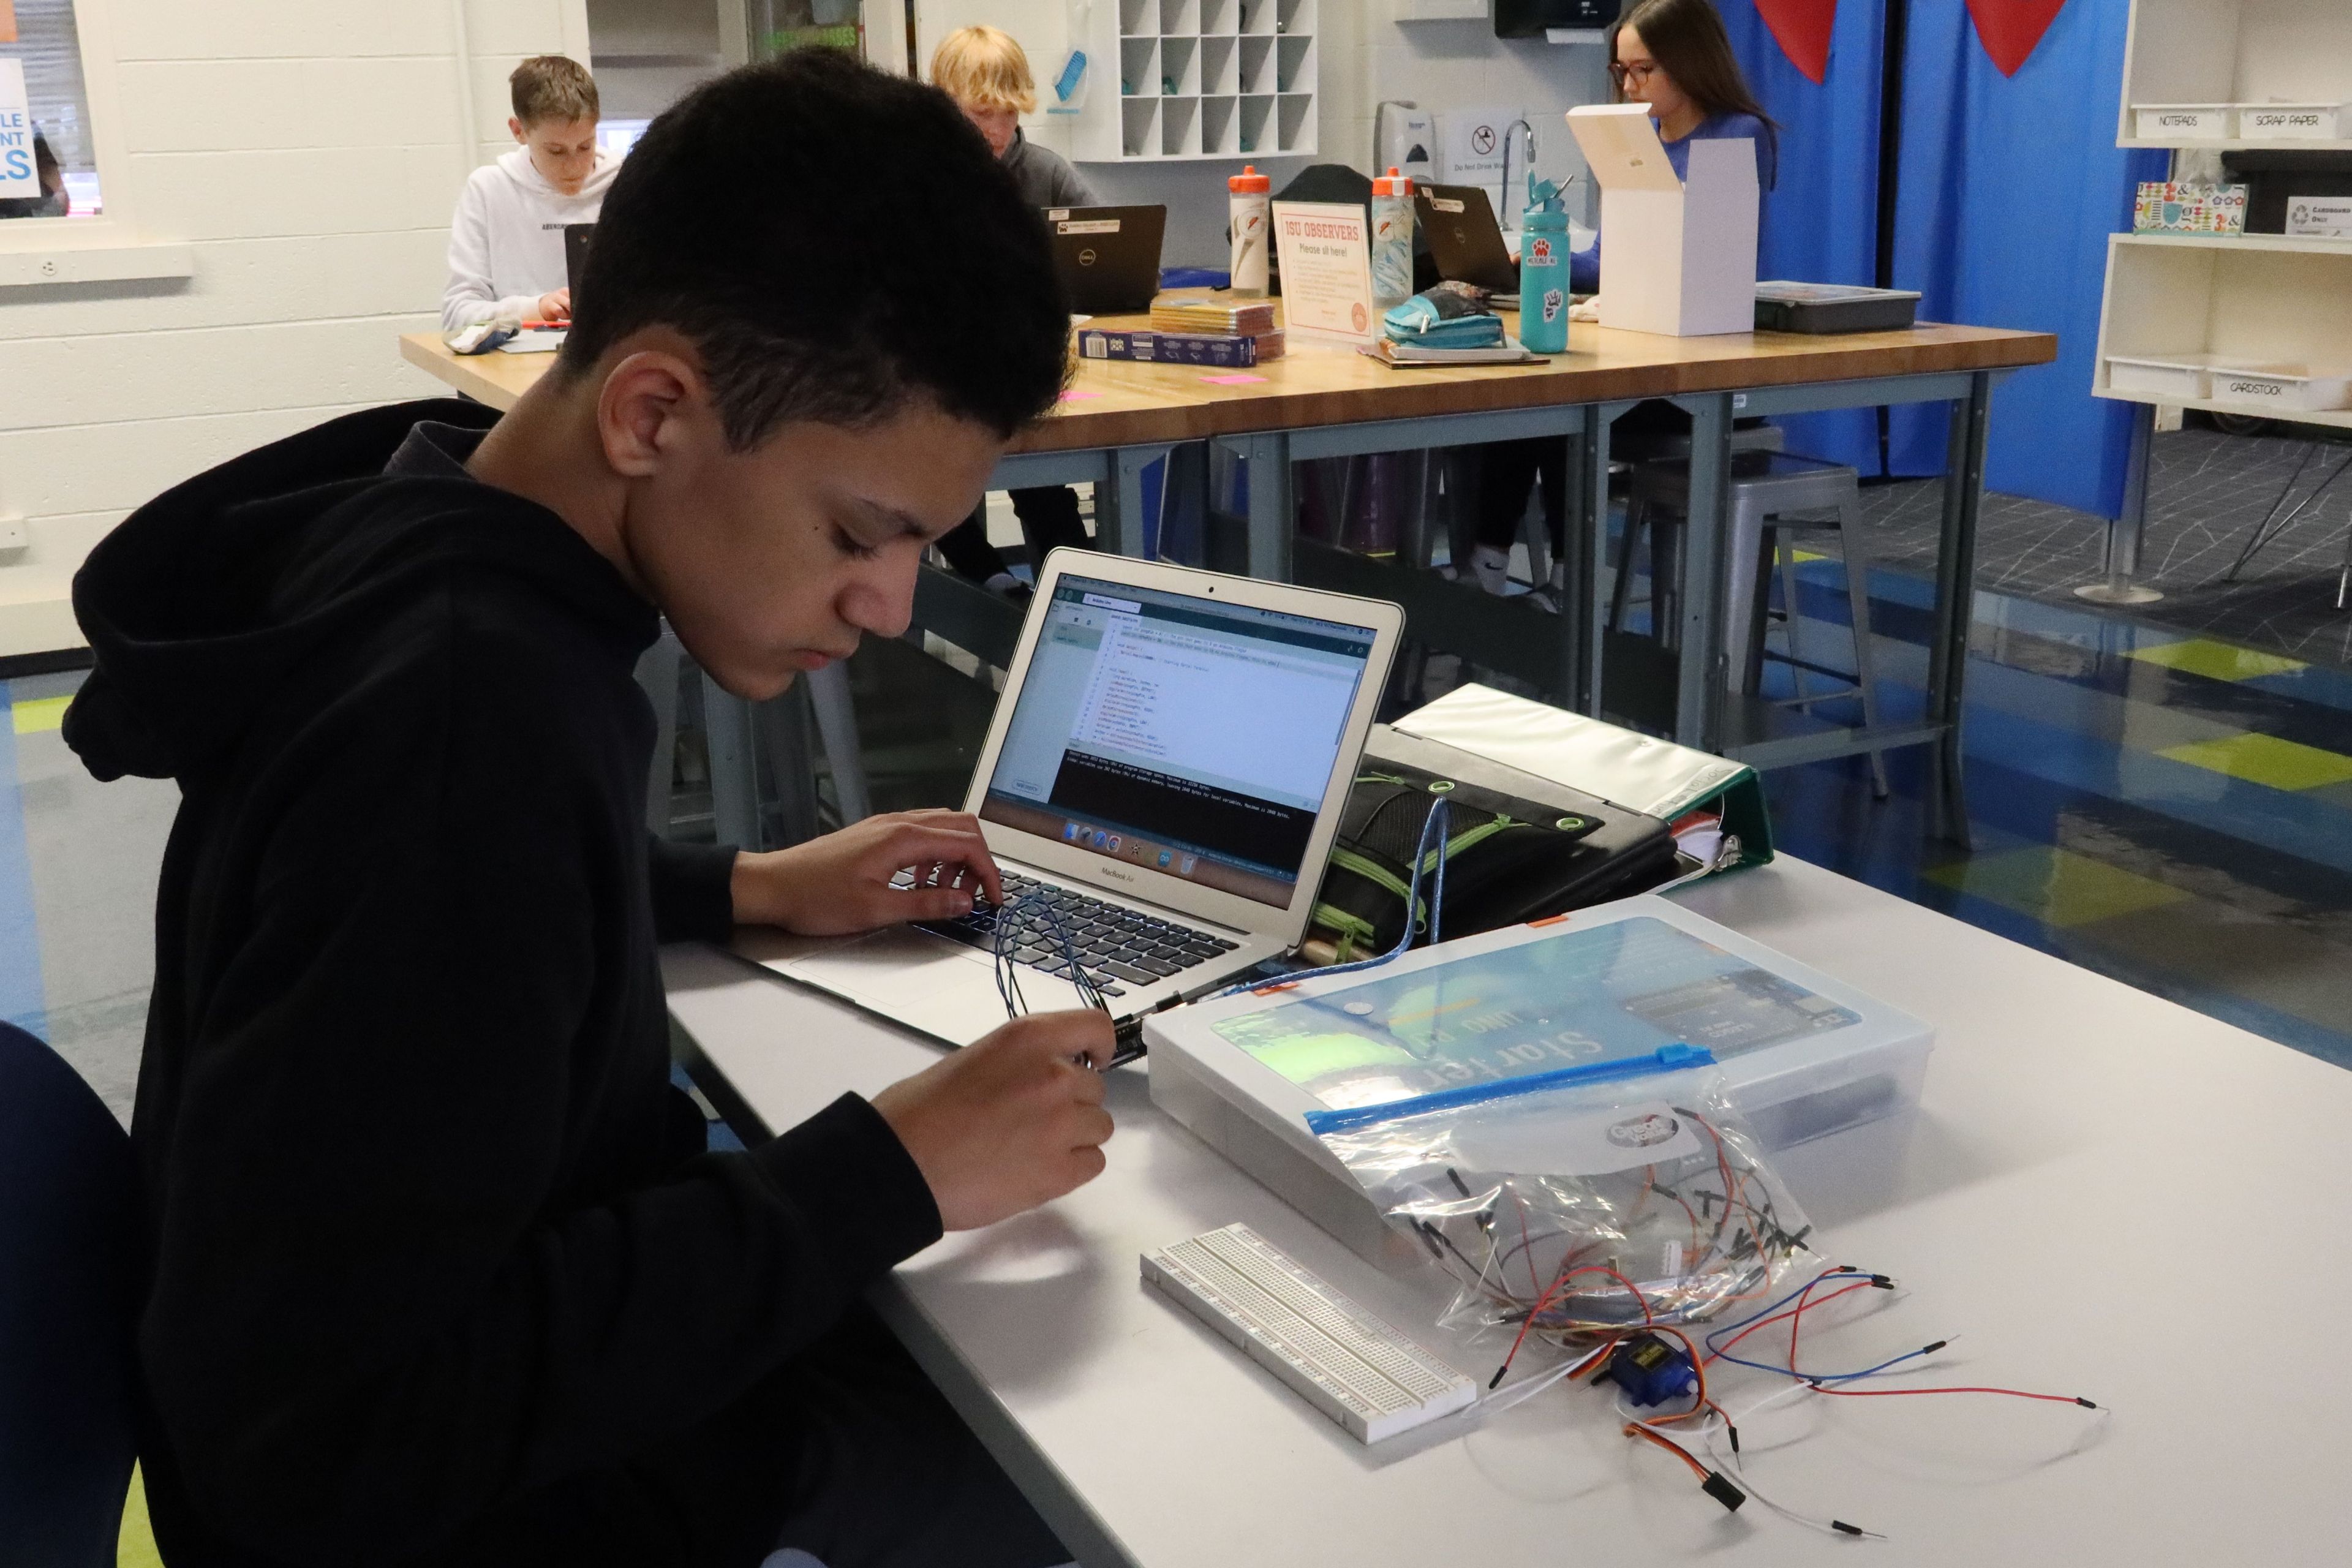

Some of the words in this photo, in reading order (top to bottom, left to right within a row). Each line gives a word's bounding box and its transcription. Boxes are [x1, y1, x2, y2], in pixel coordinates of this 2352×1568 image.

[2159, 115, 2198, 126] NOTEPADS
[2256, 115, 2286, 126] SCRAP
[2289, 115, 2319, 126] PAPER
[1286, 221, 1302, 236] ISU
[1304, 222, 1359, 241] OBSERVERS
[1299, 243, 1321, 255] Please
[1330, 246, 1347, 257] here!
[2230, 382, 2282, 396] CARDSTOCK
[1101, 867, 1126, 881] MacBook
